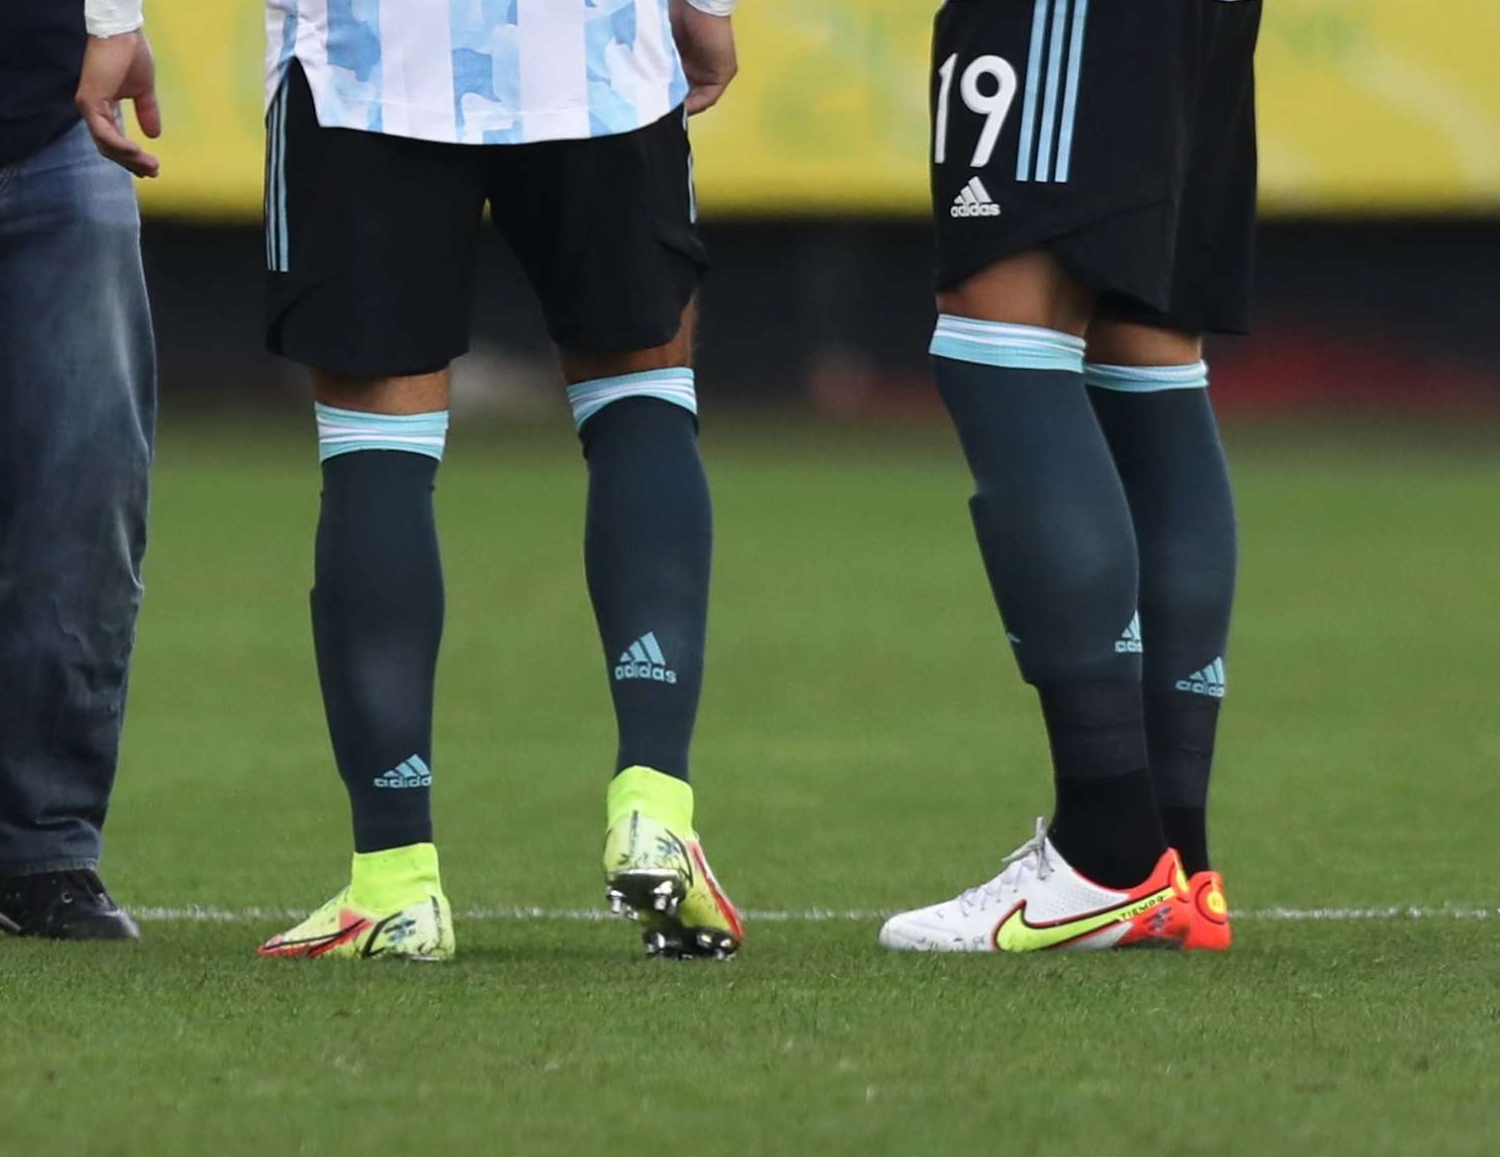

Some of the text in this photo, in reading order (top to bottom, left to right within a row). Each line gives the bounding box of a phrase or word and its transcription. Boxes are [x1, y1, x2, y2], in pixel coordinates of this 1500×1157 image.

[934, 53, 1018, 168] 19
[950, 201, 1001, 218] adidas
[615, 662, 677, 684] adidas
[1174, 679, 1225, 700] adida
[373, 775, 433, 788] adida
[1119, 893, 1166, 919] TIEMPO
